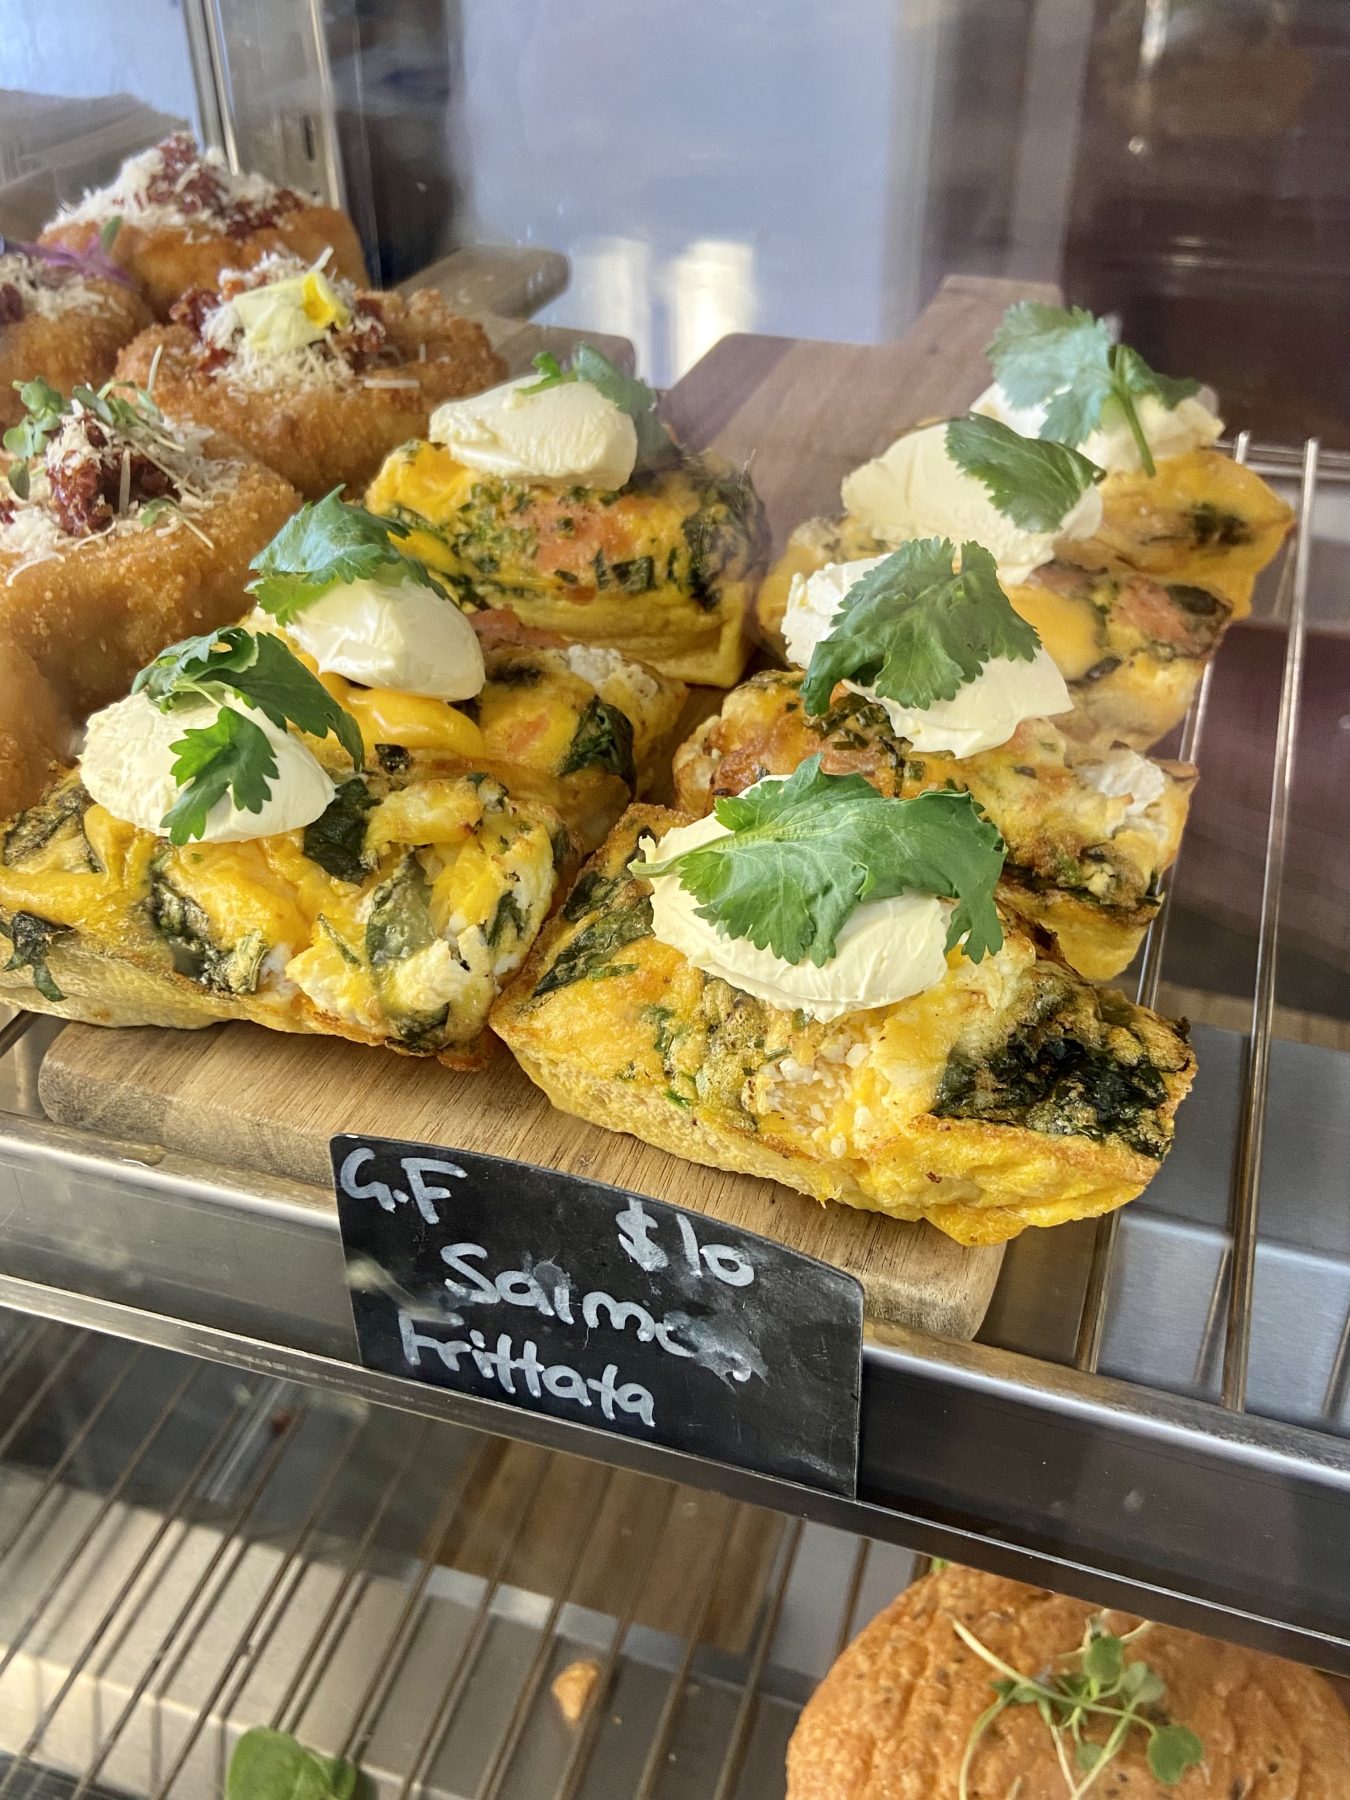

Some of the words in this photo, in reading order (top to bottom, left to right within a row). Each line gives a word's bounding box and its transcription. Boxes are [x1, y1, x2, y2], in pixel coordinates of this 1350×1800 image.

[340, 1147, 468, 1224] G.F
[615, 1199, 755, 1287] $10
[440, 1243, 762, 1383] Salmo
[399, 1311, 656, 1428] Frittata
